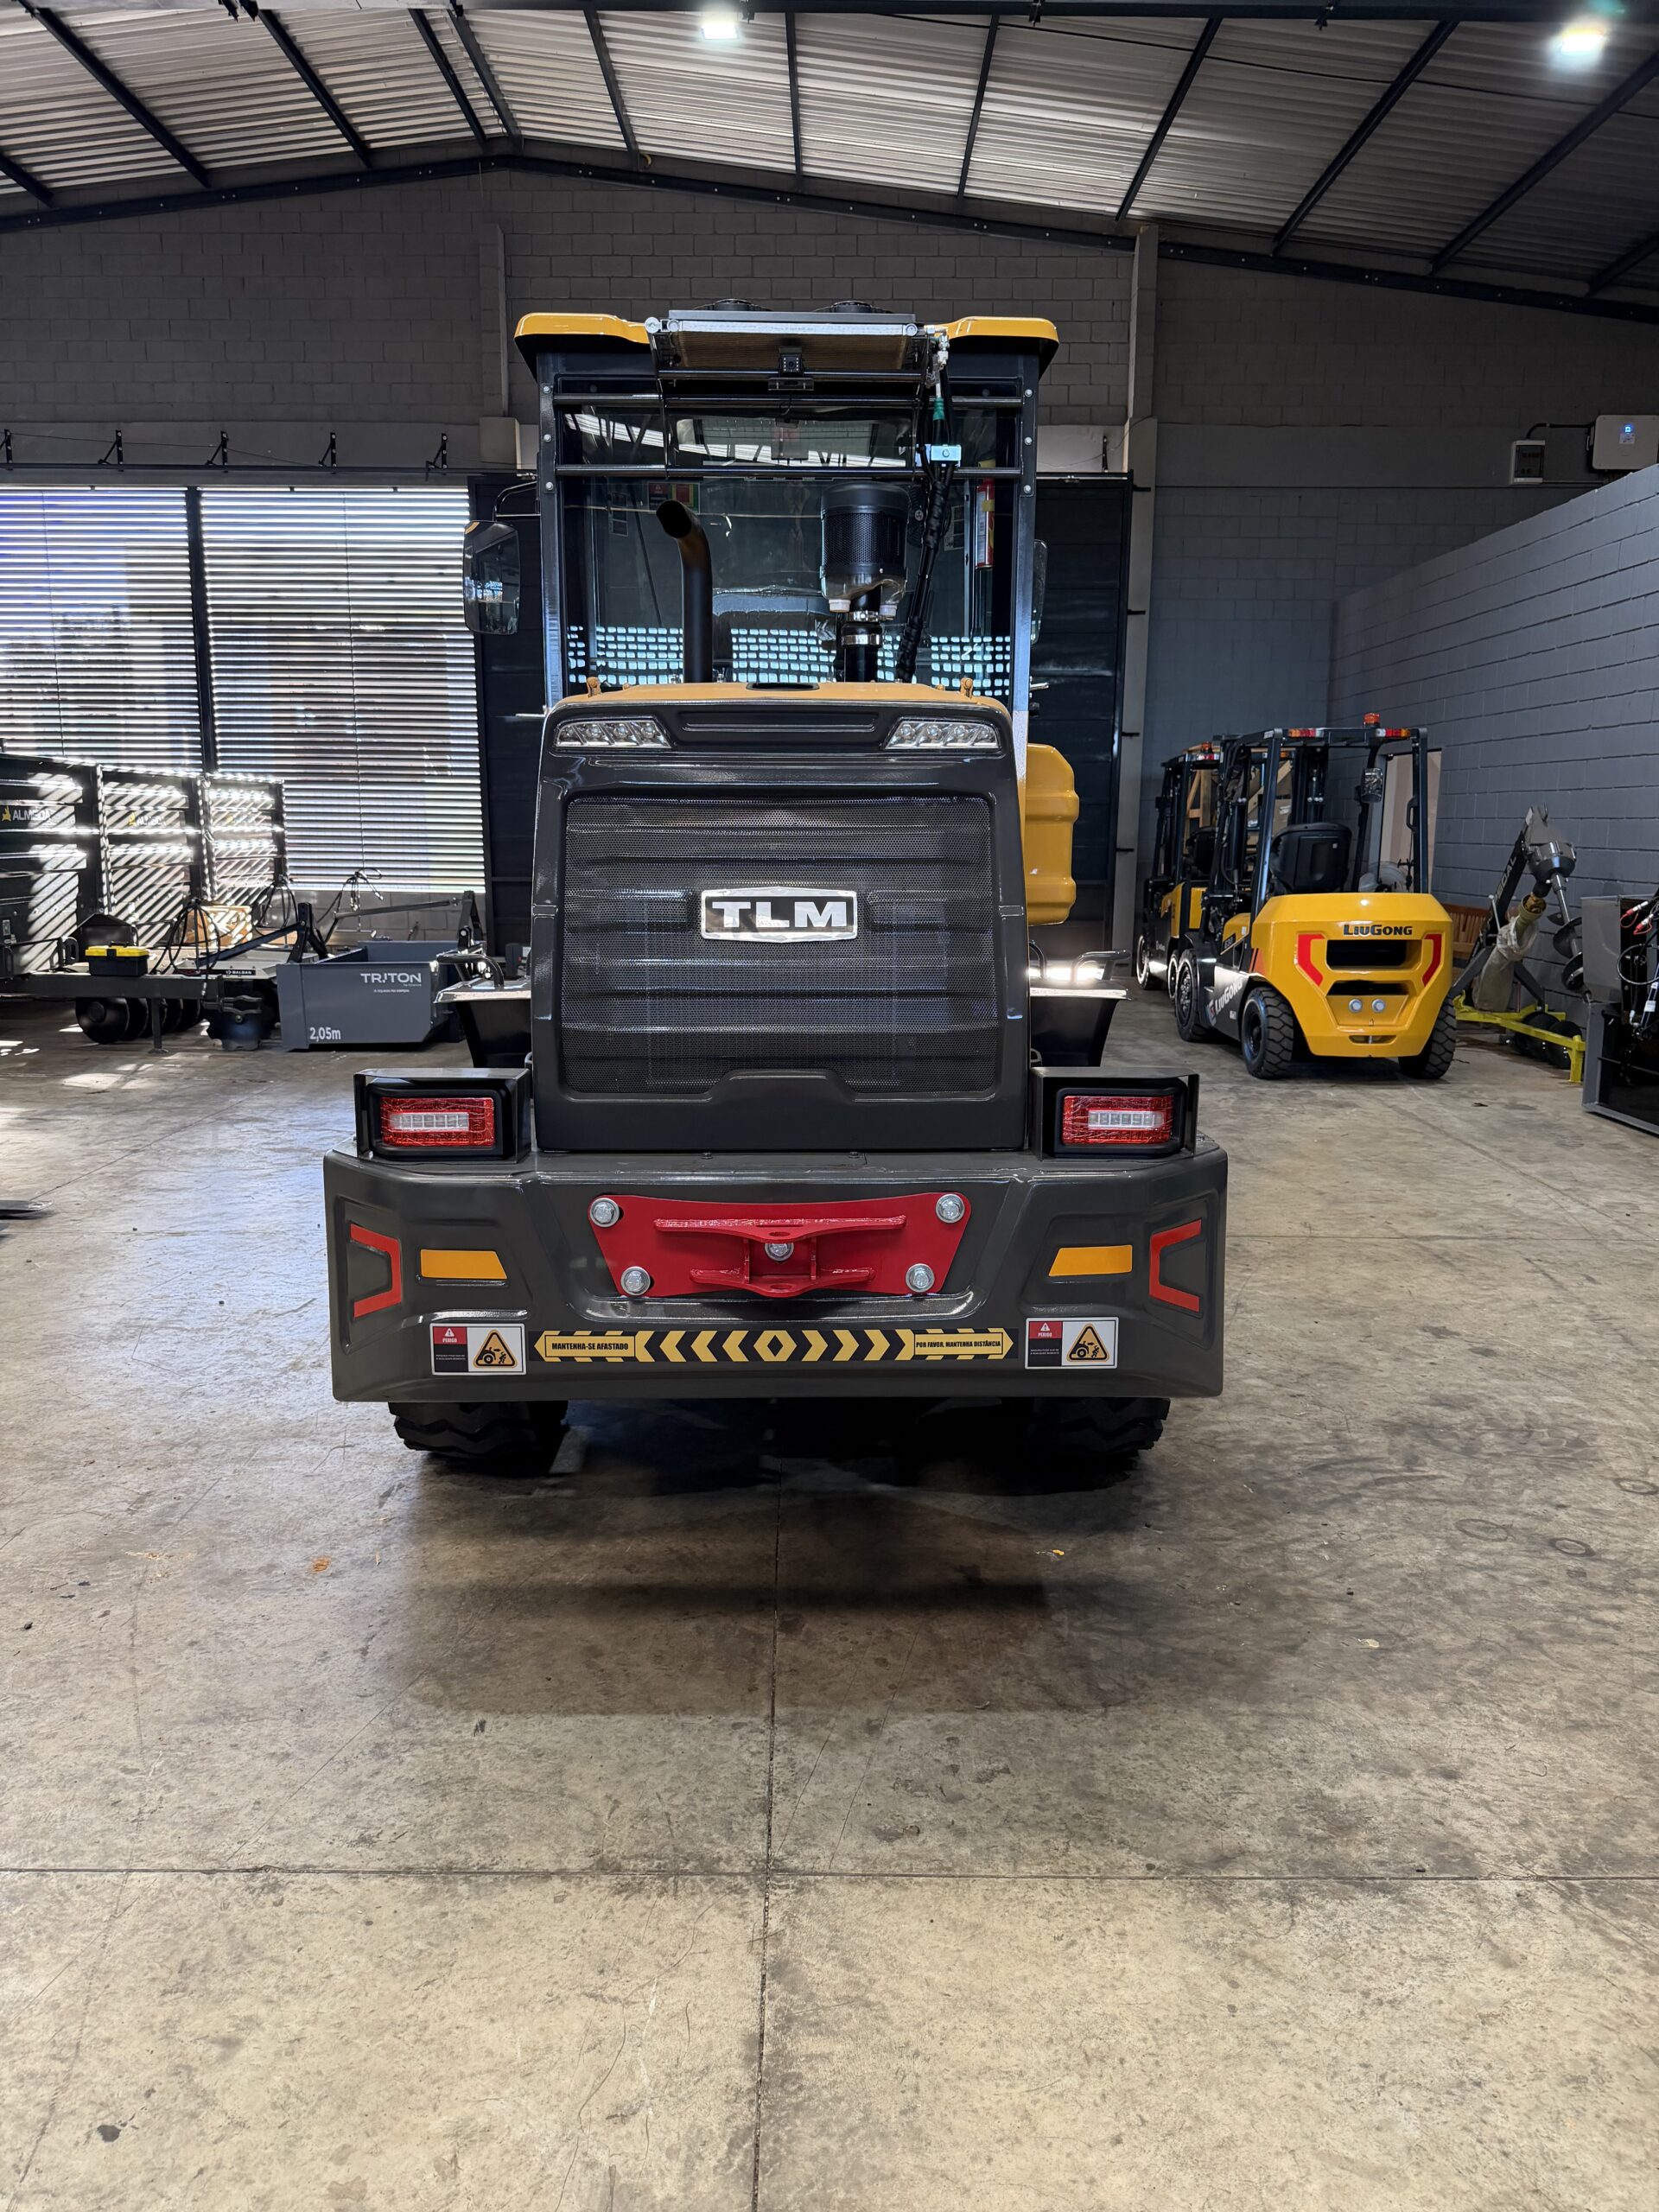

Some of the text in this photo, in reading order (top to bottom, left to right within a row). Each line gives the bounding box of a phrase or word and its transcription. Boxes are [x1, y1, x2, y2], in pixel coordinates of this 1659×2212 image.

[711, 901, 848, 928] TLM
[359, 972, 423, 983] TRITON
[309, 1027, 341, 1042] 2,05m
[551, 1342, 595, 1351] MANTENHA-SE
